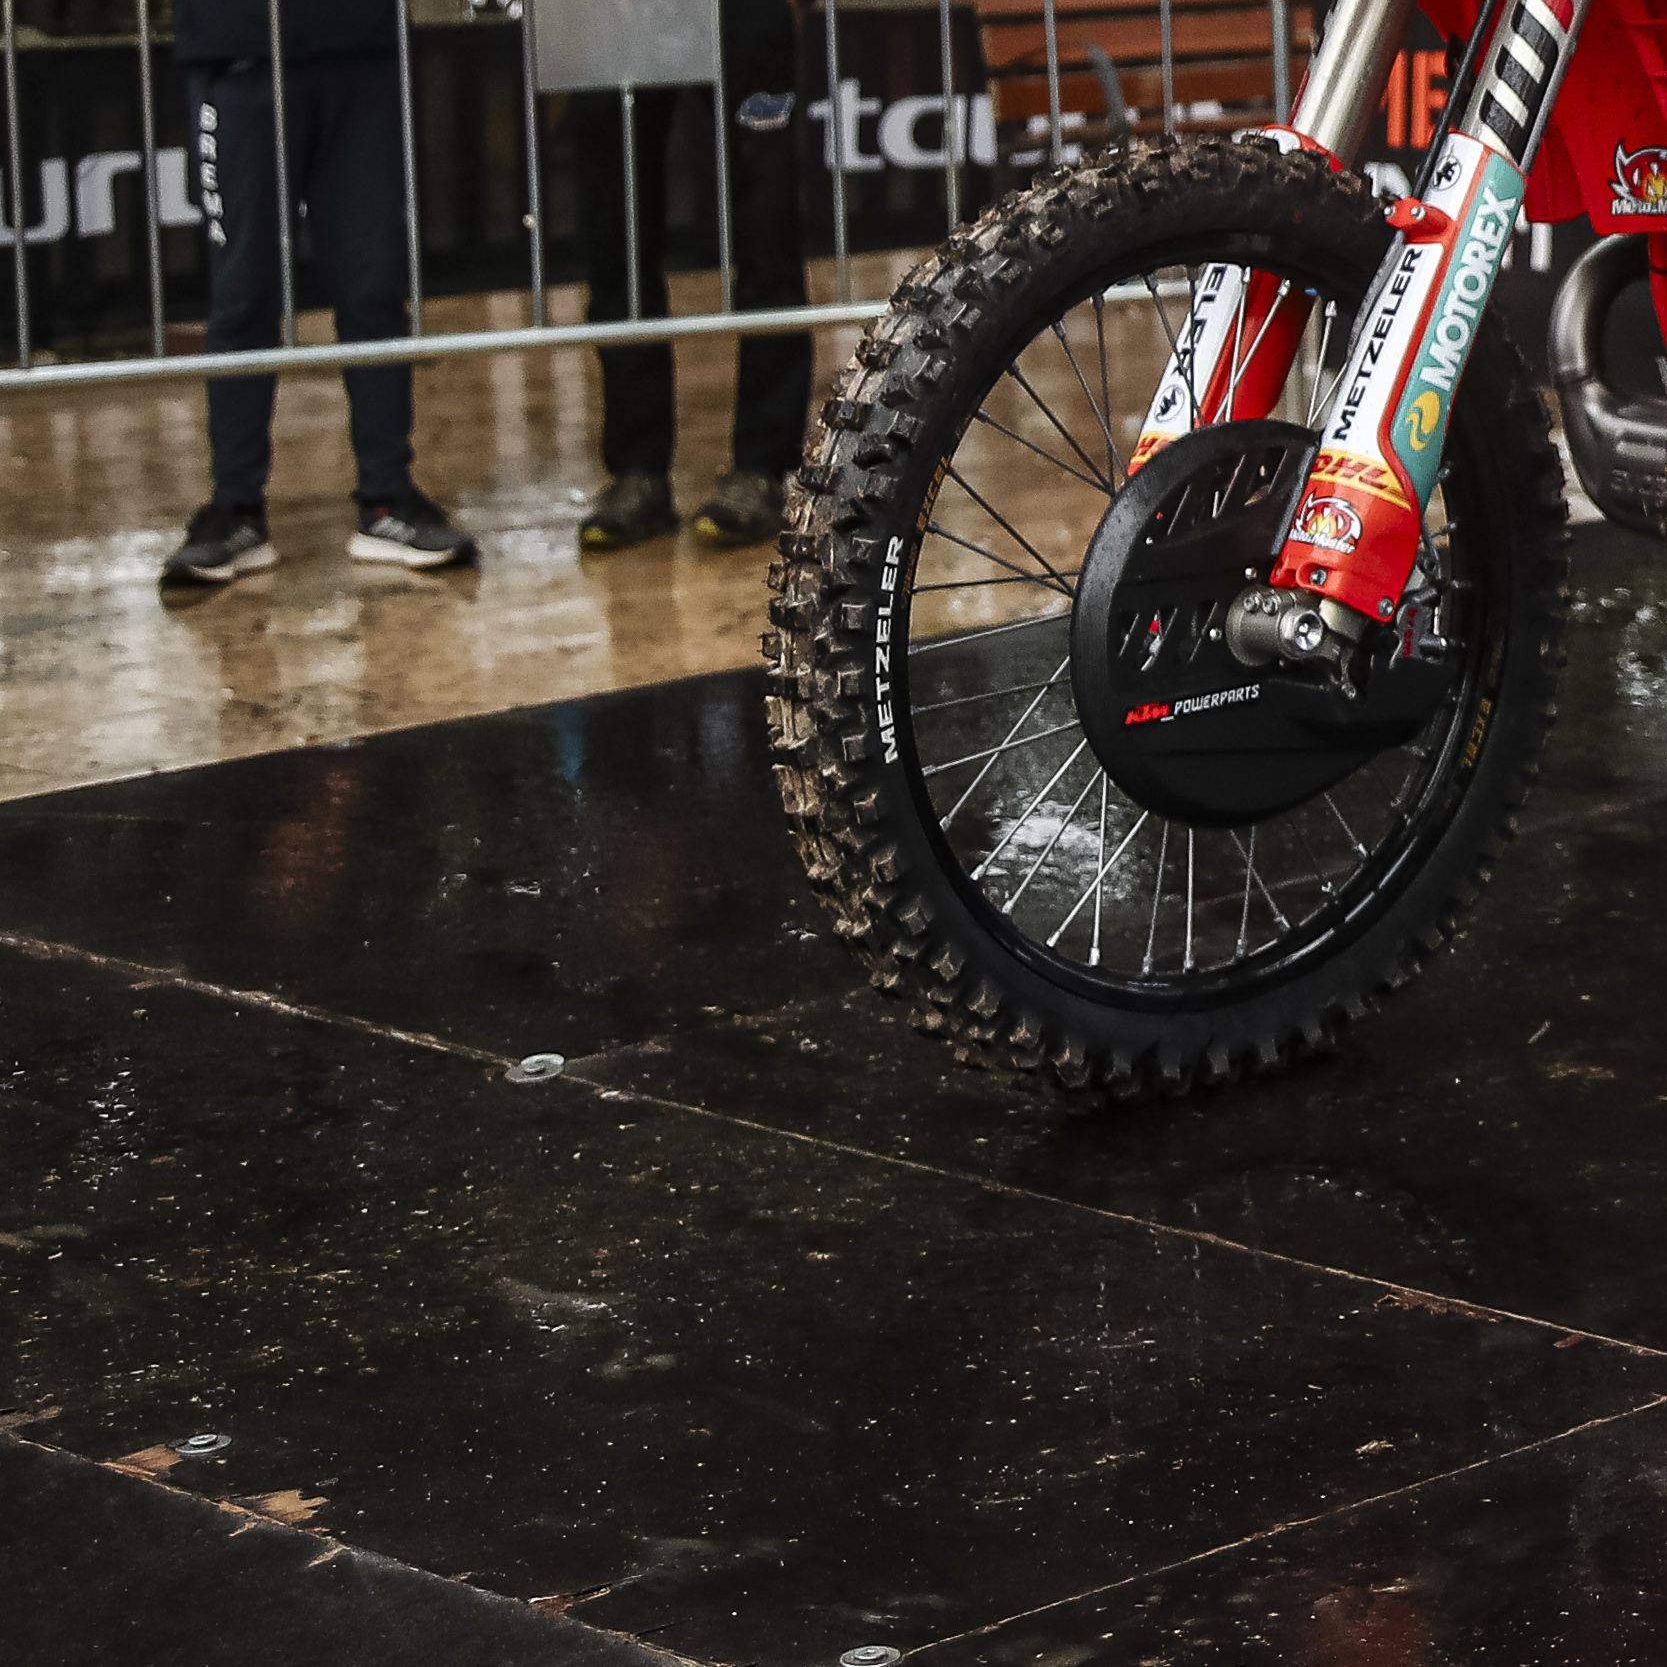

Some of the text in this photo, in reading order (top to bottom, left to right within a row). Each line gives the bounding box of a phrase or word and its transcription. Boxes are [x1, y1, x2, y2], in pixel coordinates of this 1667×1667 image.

[1332, 246, 1424, 442] METZELER
[1419, 194, 1518, 392] MOTOREX
[875, 534, 904, 765] METZELER
[1125, 701, 1172, 726] KTM
